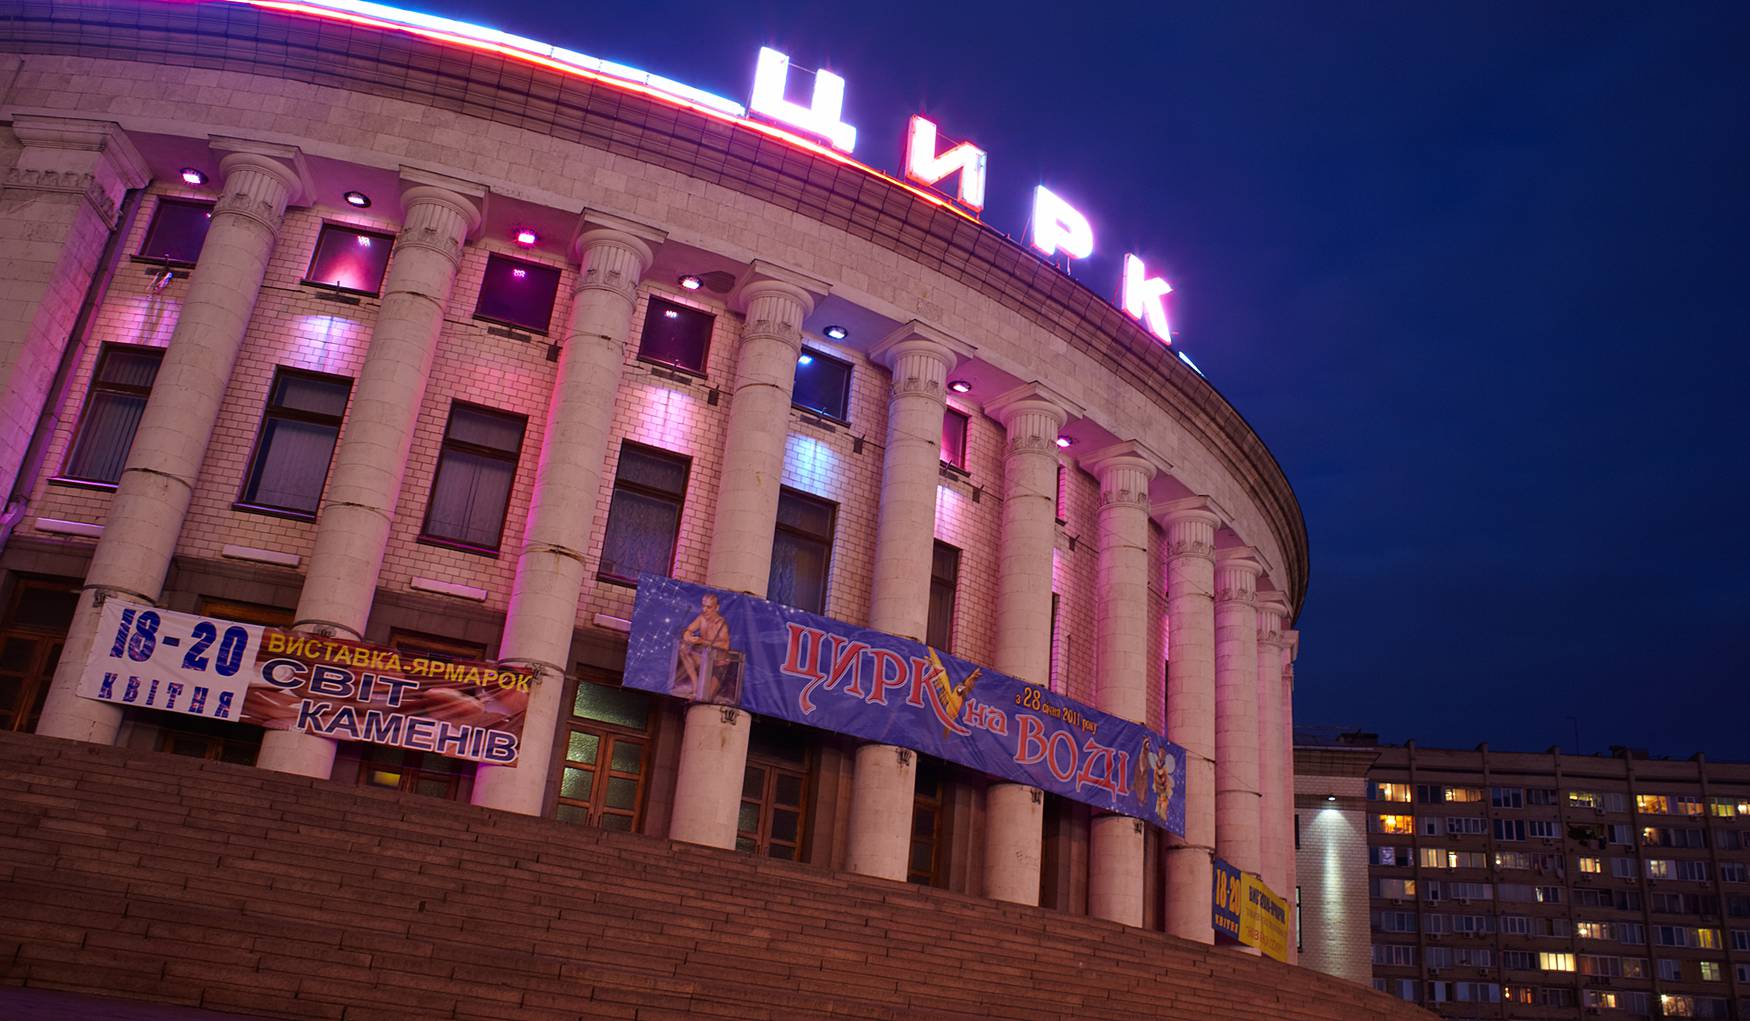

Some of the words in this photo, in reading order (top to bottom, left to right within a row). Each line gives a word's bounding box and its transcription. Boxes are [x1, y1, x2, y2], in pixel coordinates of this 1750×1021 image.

[749, 46, 1173, 345] ЦИРК
[109, 607, 249, 677] 18-20
[268, 632, 533, 694] ВИСТАВКА-ЯРМАРОК
[98, 671, 235, 719] КВІТНЯ
[261, 657, 420, 707] СВІТ
[780, 622, 971, 736] ЦИРК
[963, 697, 1008, 736] на
[1014, 713, 1130, 802] ВОДІ
[1023, 686, 1041, 710] 28
[1062, 707, 1080, 726] 2011
[297, 699, 518, 764] КАМЕНІВ
